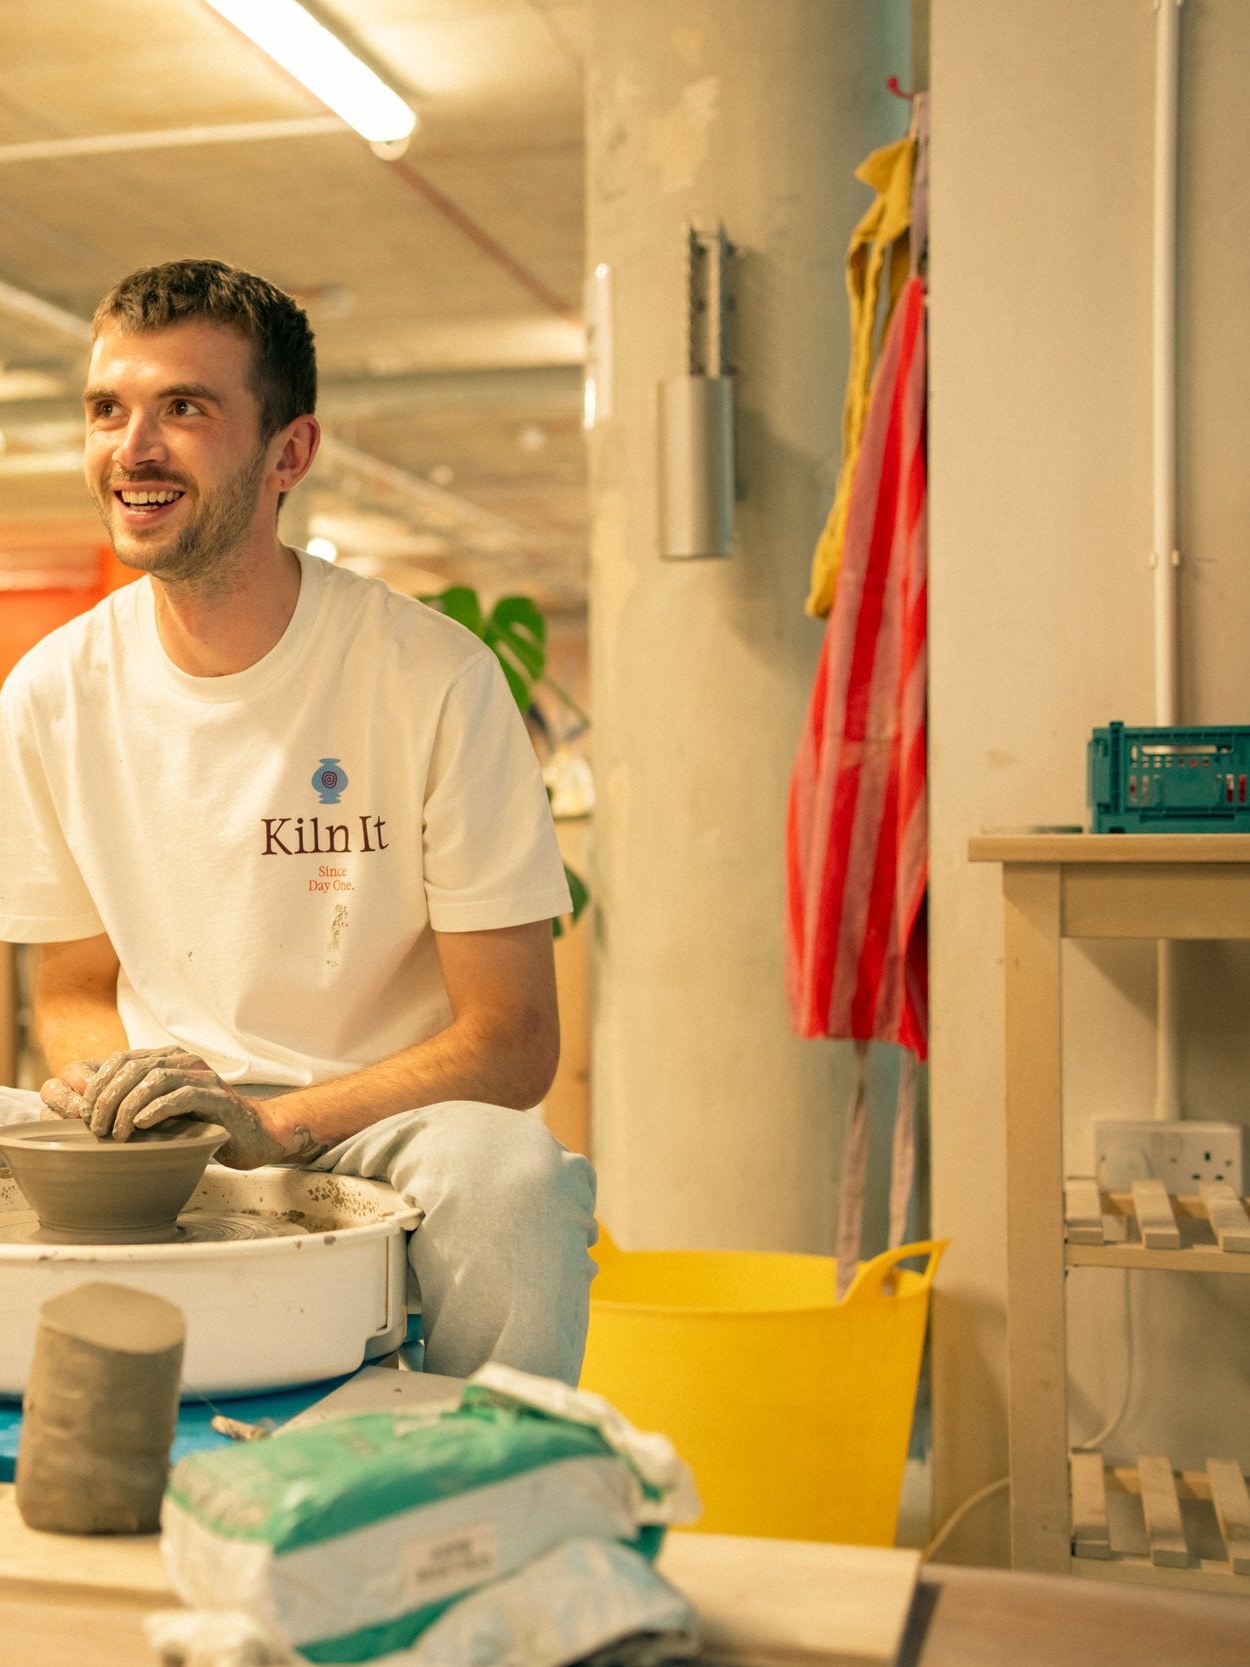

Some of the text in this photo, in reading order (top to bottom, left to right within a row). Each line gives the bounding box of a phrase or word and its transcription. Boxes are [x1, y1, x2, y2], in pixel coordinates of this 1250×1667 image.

[261, 815, 389, 855] Kiln It
[318, 865, 347, 877] Since
[309, 879, 355, 893] Day One.
